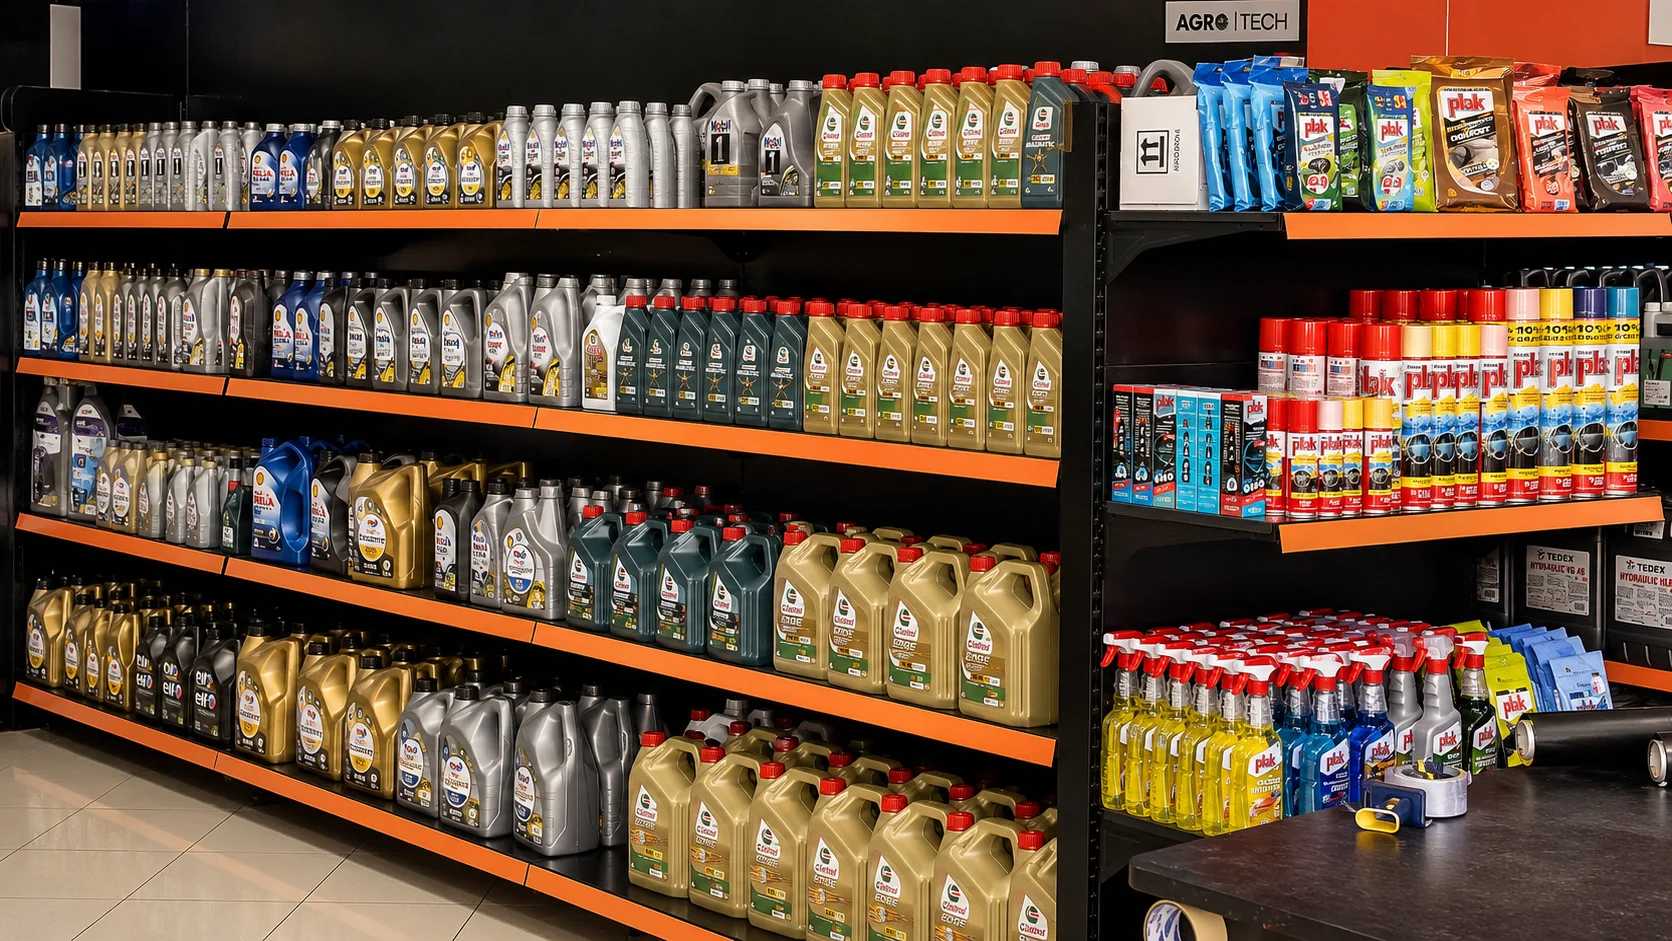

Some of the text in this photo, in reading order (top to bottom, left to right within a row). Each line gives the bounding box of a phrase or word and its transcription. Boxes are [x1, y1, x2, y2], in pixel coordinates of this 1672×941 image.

[1240, 13, 1288, 30] TECH
[1448, 93, 1485, 118] plak
[1305, 119, 1328, 138] plak
[1382, 121, 1403, 140] plak
[1535, 116, 1558, 135] plak
[1593, 117, 1620, 135] plak
[716, 136, 724, 162] 1
[769, 152, 775, 173] 1
[1292, 436, 1317, 456] plak
[1546, 552, 1574, 563] TEDEX
[1637, 563, 1666, 574] TEDEX
[1503, 694, 1527, 719] plak
[1403, 729, 1413, 751] pl
[1439, 730, 1457, 753] plak
[1371, 742, 1390, 759] plak
[1255, 753, 1276, 774] plak
[1327, 751, 1344, 772] plak
